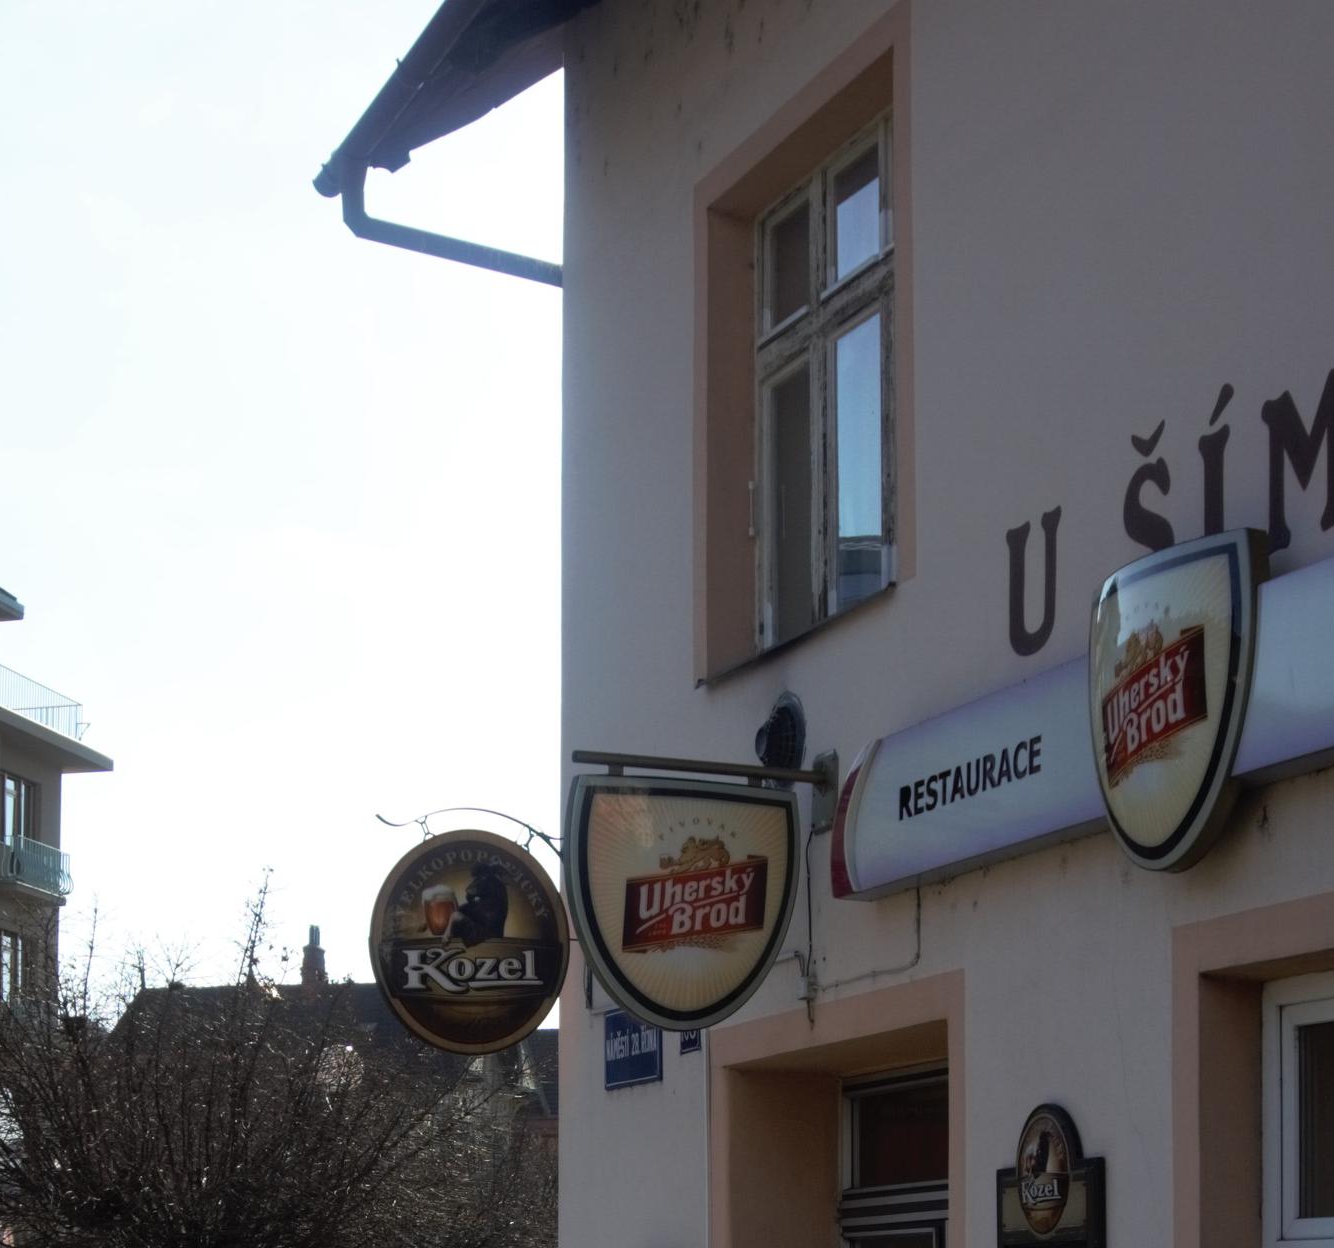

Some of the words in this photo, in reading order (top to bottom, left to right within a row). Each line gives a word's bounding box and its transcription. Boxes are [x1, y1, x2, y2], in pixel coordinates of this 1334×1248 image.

[1006, 506, 1061, 658] U
[1107, 645, 1191, 745] Uherský
[1122, 682, 1187, 755] Brod
[898, 736, 1042, 820] RESTAURACE
[638, 867, 755, 920] Uherský
[668, 894, 748, 936] Brod
[403, 947, 541, 992] Kozel
[1021, 1178, 1061, 1205] Kozel
